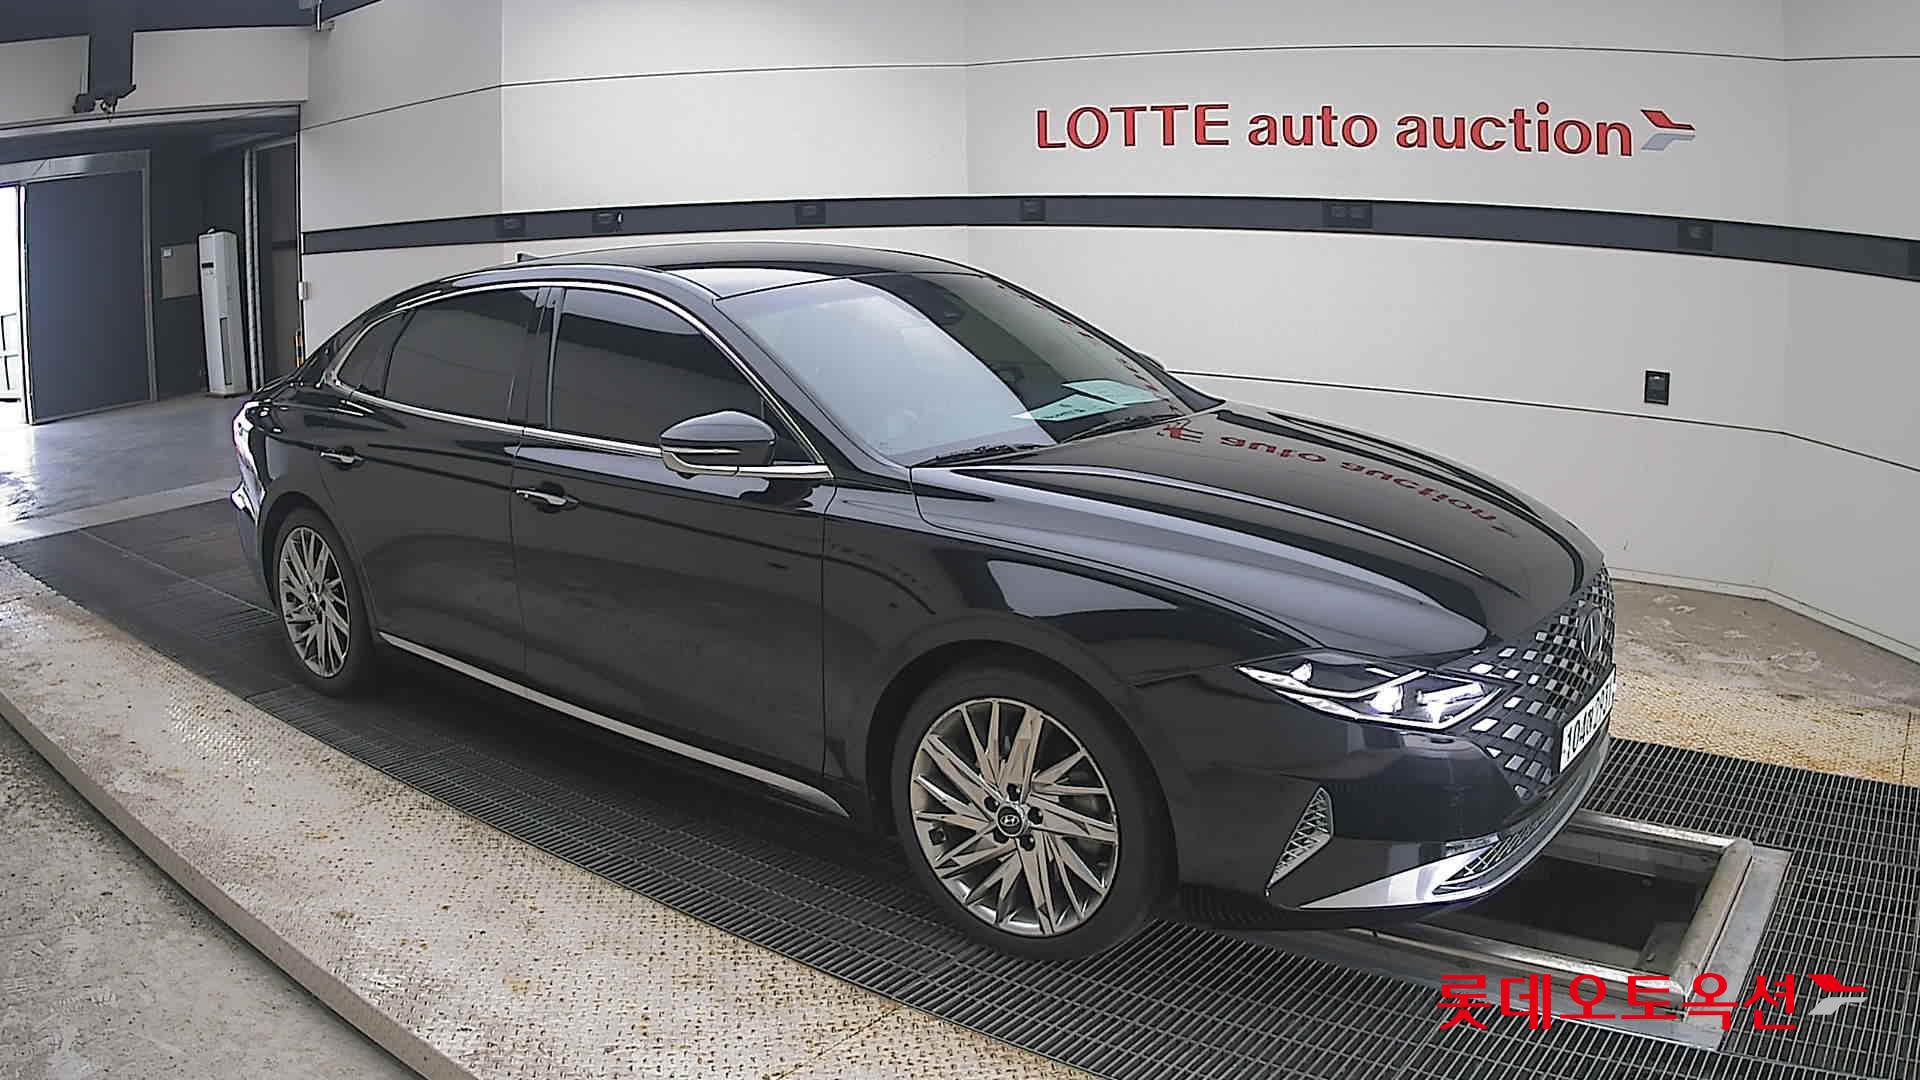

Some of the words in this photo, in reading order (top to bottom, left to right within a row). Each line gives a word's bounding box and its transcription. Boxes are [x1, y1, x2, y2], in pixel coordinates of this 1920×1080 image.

[1036, 103, 1230, 149] LOTTE
[1247, 104, 1378, 147] auto
[1396, 101, 1633, 157] auction
